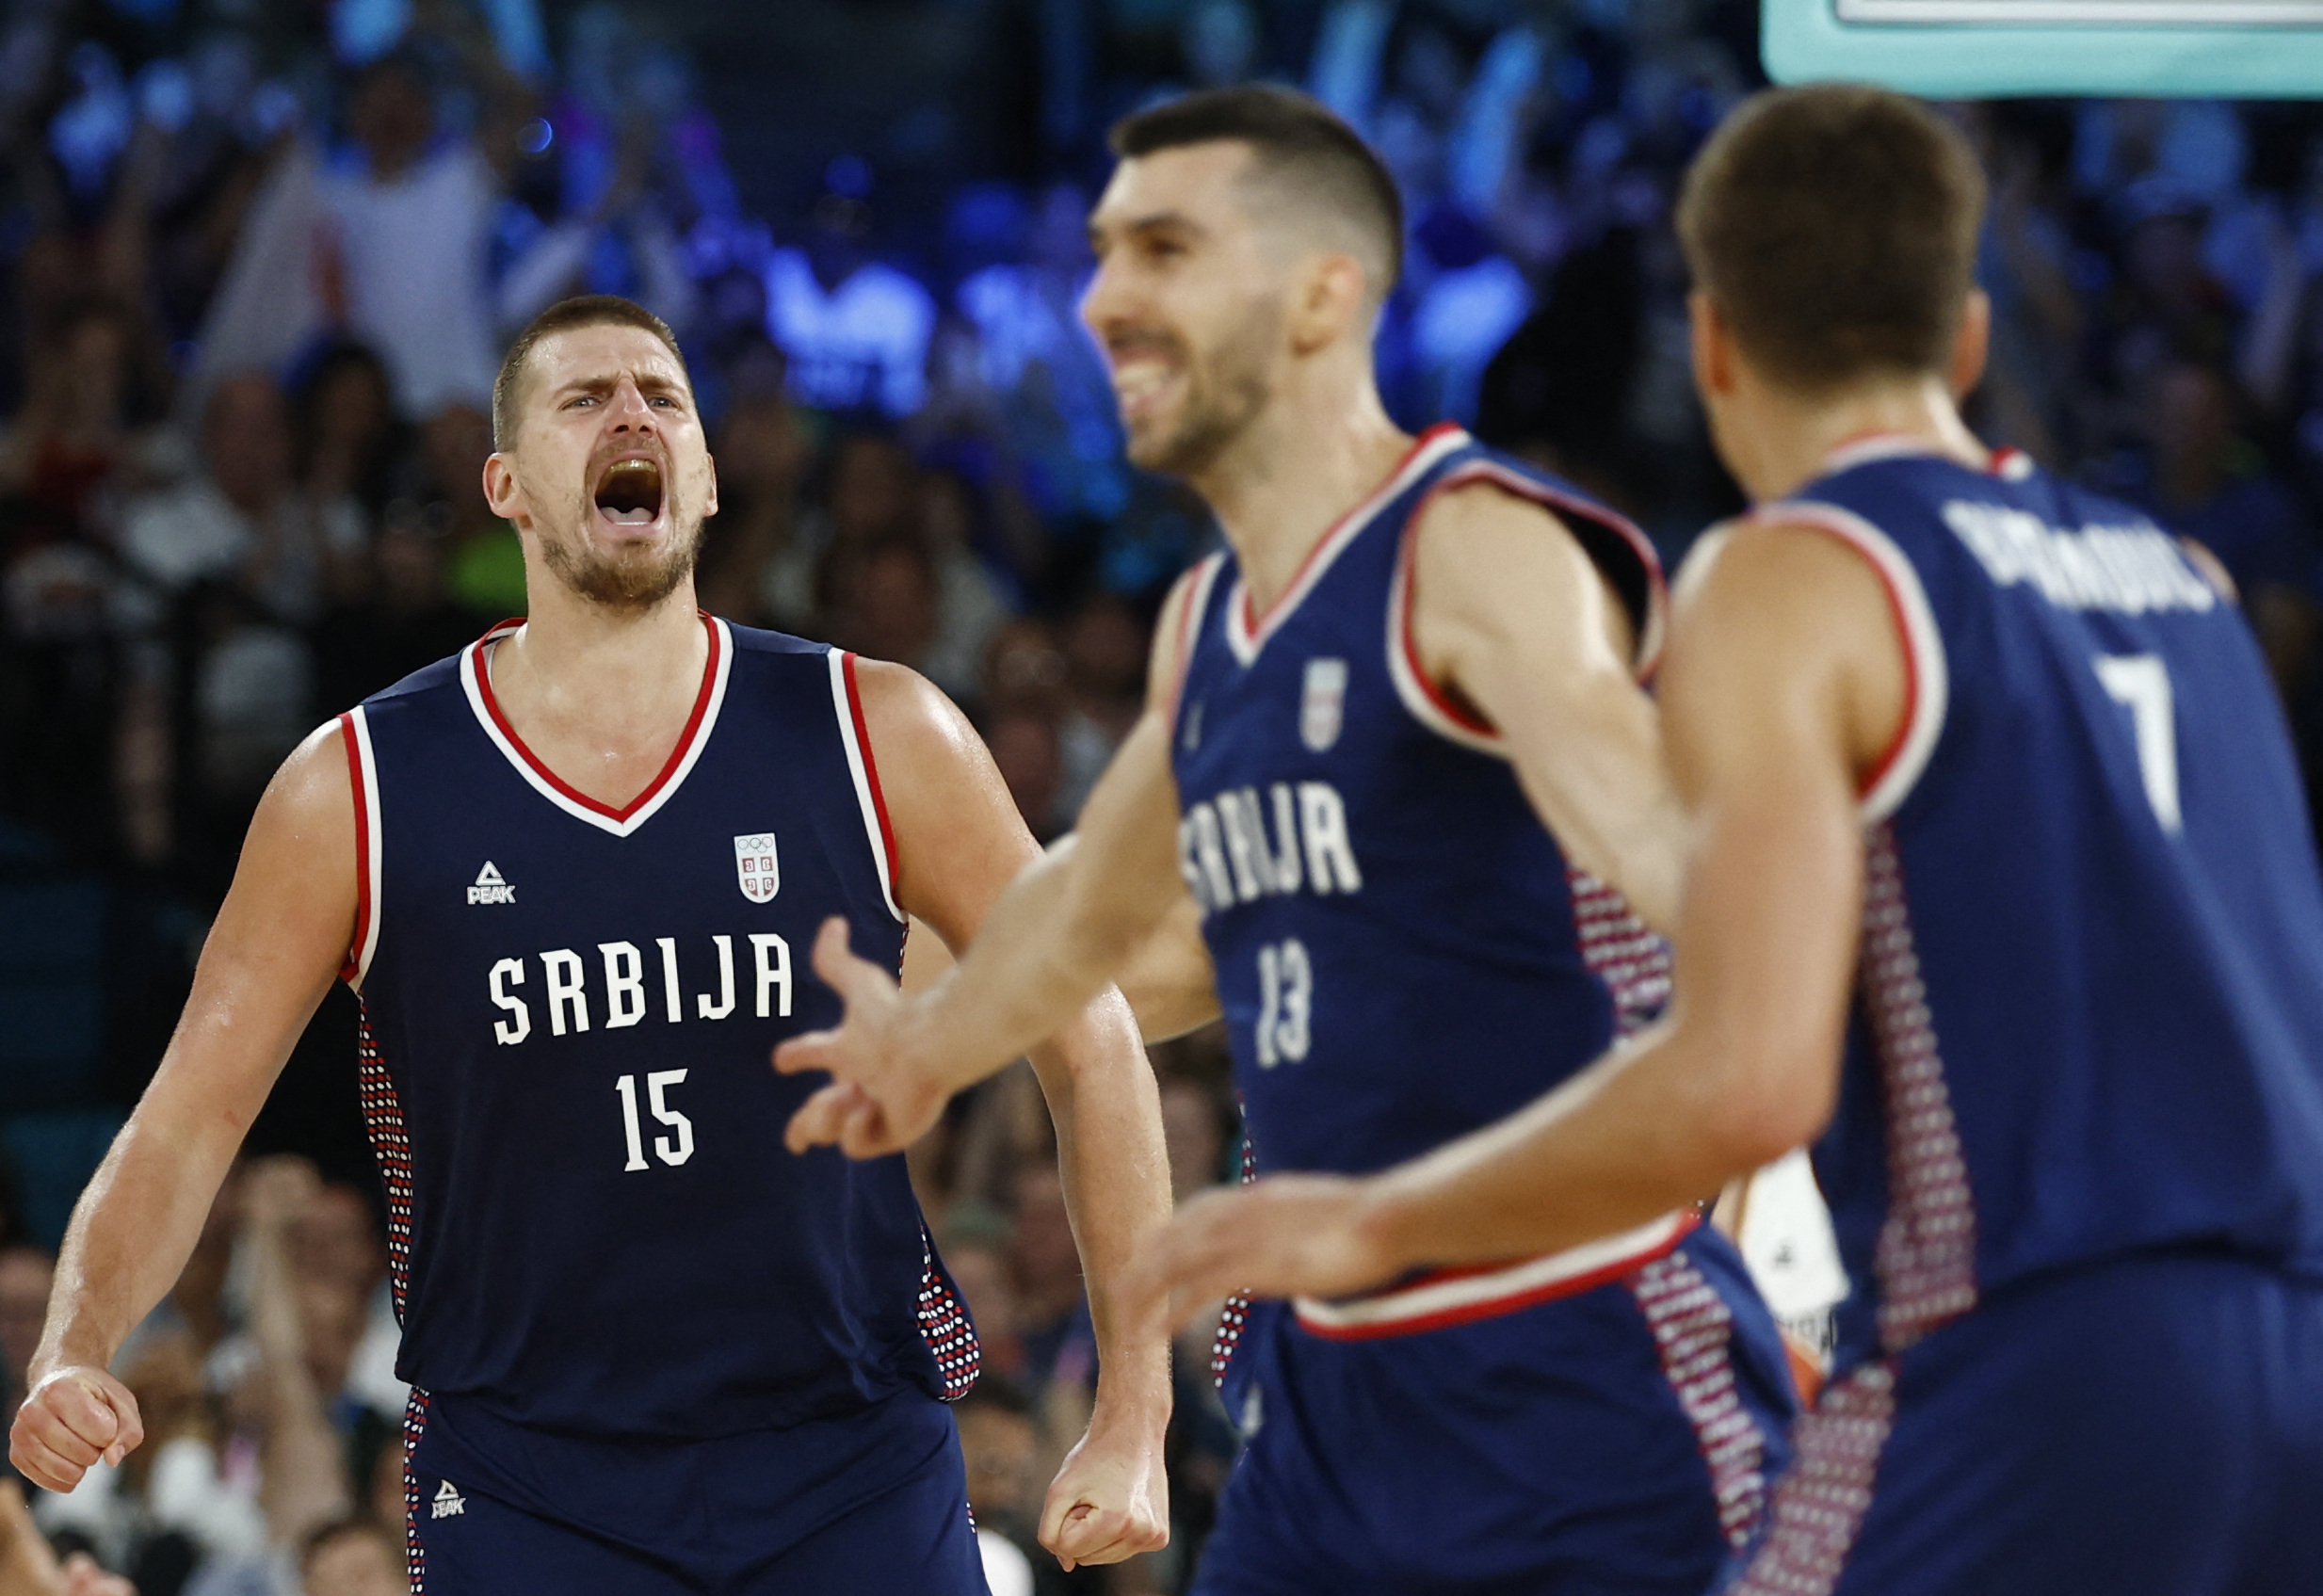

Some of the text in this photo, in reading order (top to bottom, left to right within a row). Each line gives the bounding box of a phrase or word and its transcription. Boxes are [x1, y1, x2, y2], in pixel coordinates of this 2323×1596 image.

[2094, 654, 2183, 833] 7
[467, 885, 516, 905] PEAK
[489, 933, 793, 1046] SRBIJA
[1255, 938, 1313, 1069] 13
[615, 1068, 695, 1172] 15
[430, 1497, 467, 1519] PEAK
